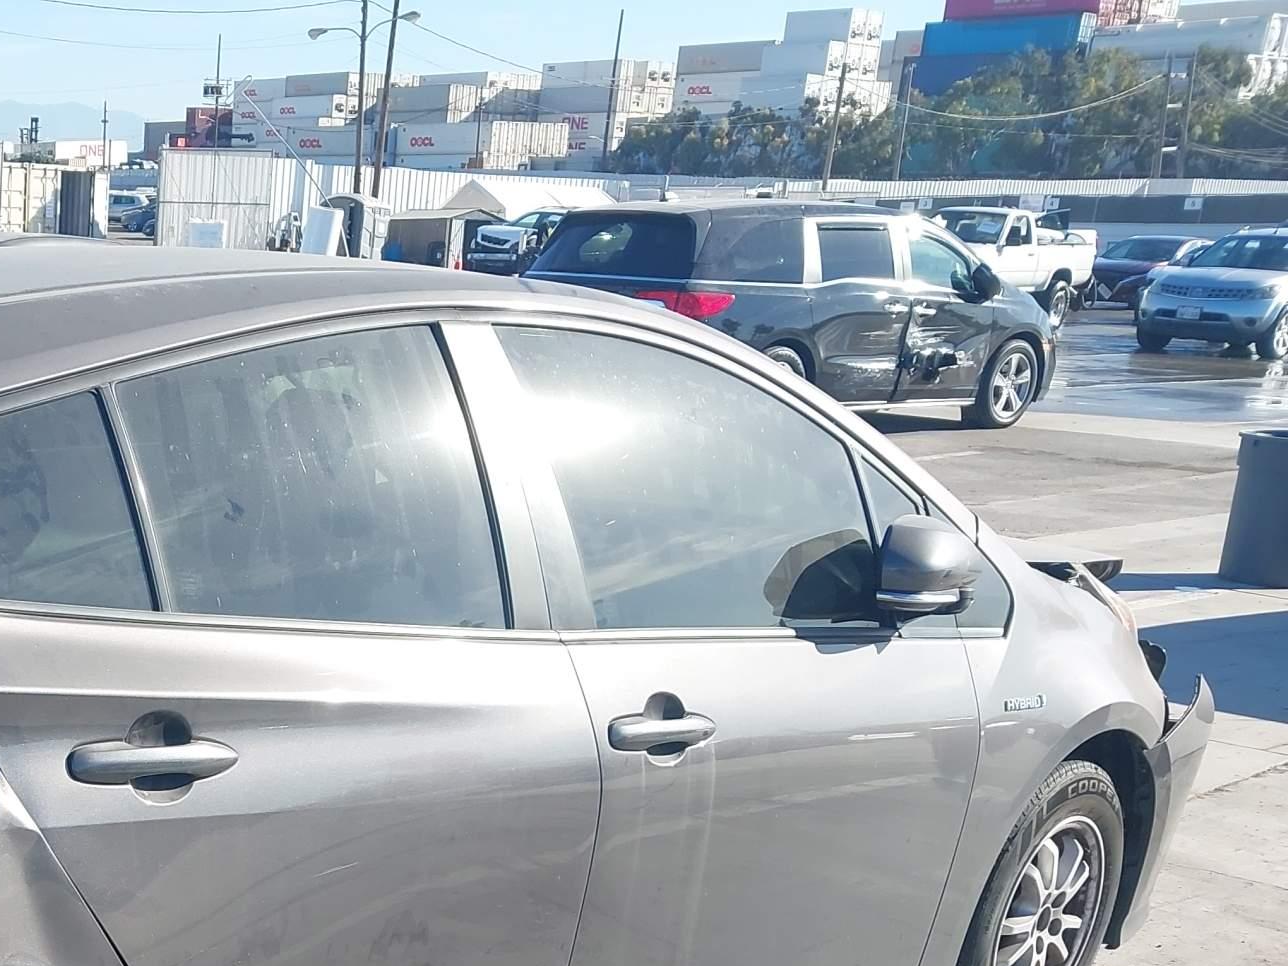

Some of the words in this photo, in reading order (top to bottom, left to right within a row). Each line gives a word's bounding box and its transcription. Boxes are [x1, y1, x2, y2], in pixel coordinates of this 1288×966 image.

[687, 86, 712, 95] OOCL
[299, 139, 322, 148] OOCL
[410, 136, 434, 147] OOCL
[1007, 696, 1041, 711] HYBRID
[1067, 780, 1122, 811] COOPER
